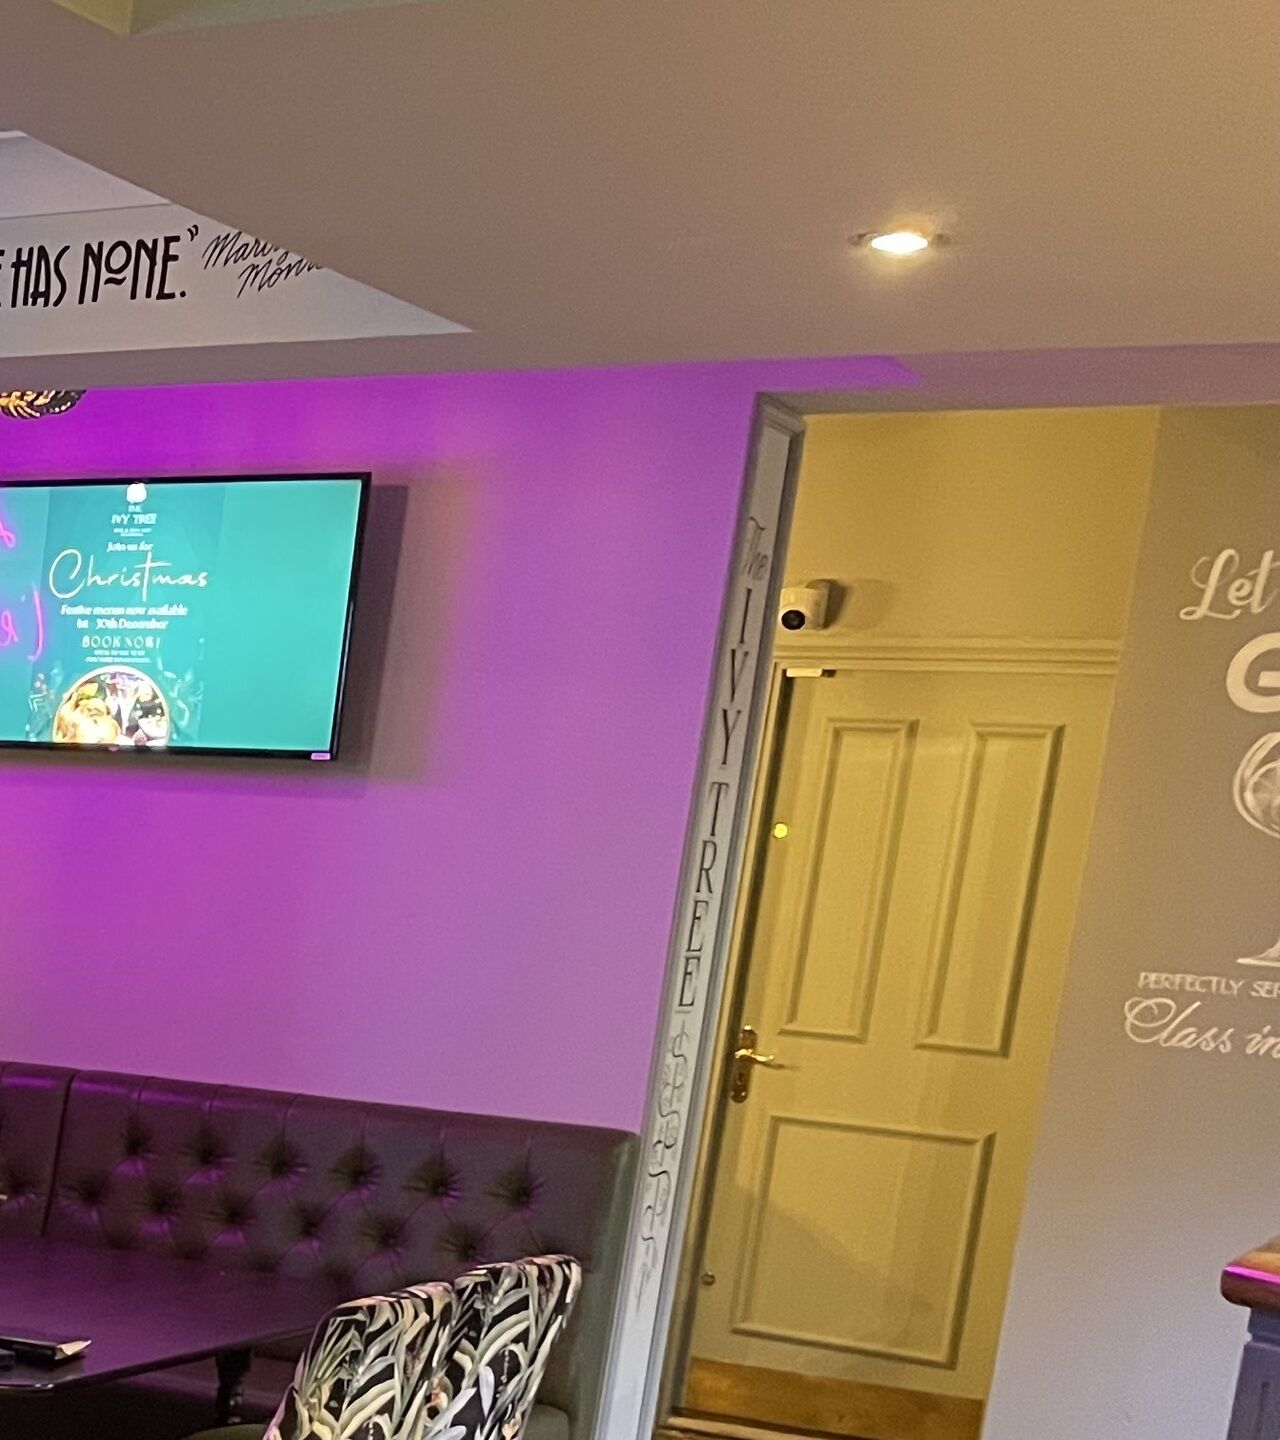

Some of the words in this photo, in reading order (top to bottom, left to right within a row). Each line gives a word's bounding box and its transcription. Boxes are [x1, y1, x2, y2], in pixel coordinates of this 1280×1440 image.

[10, 244, 69, 310] HAS
[49, 548, 208, 602] Christmas
[82, 635, 121, 648] BOOK
[720, 588, 753, 766] IVY
[676, 781, 730, 1008] TREE
[1138, 971, 1245, 996] PERFECTLY
[1124, 997, 1235, 1053] Class
